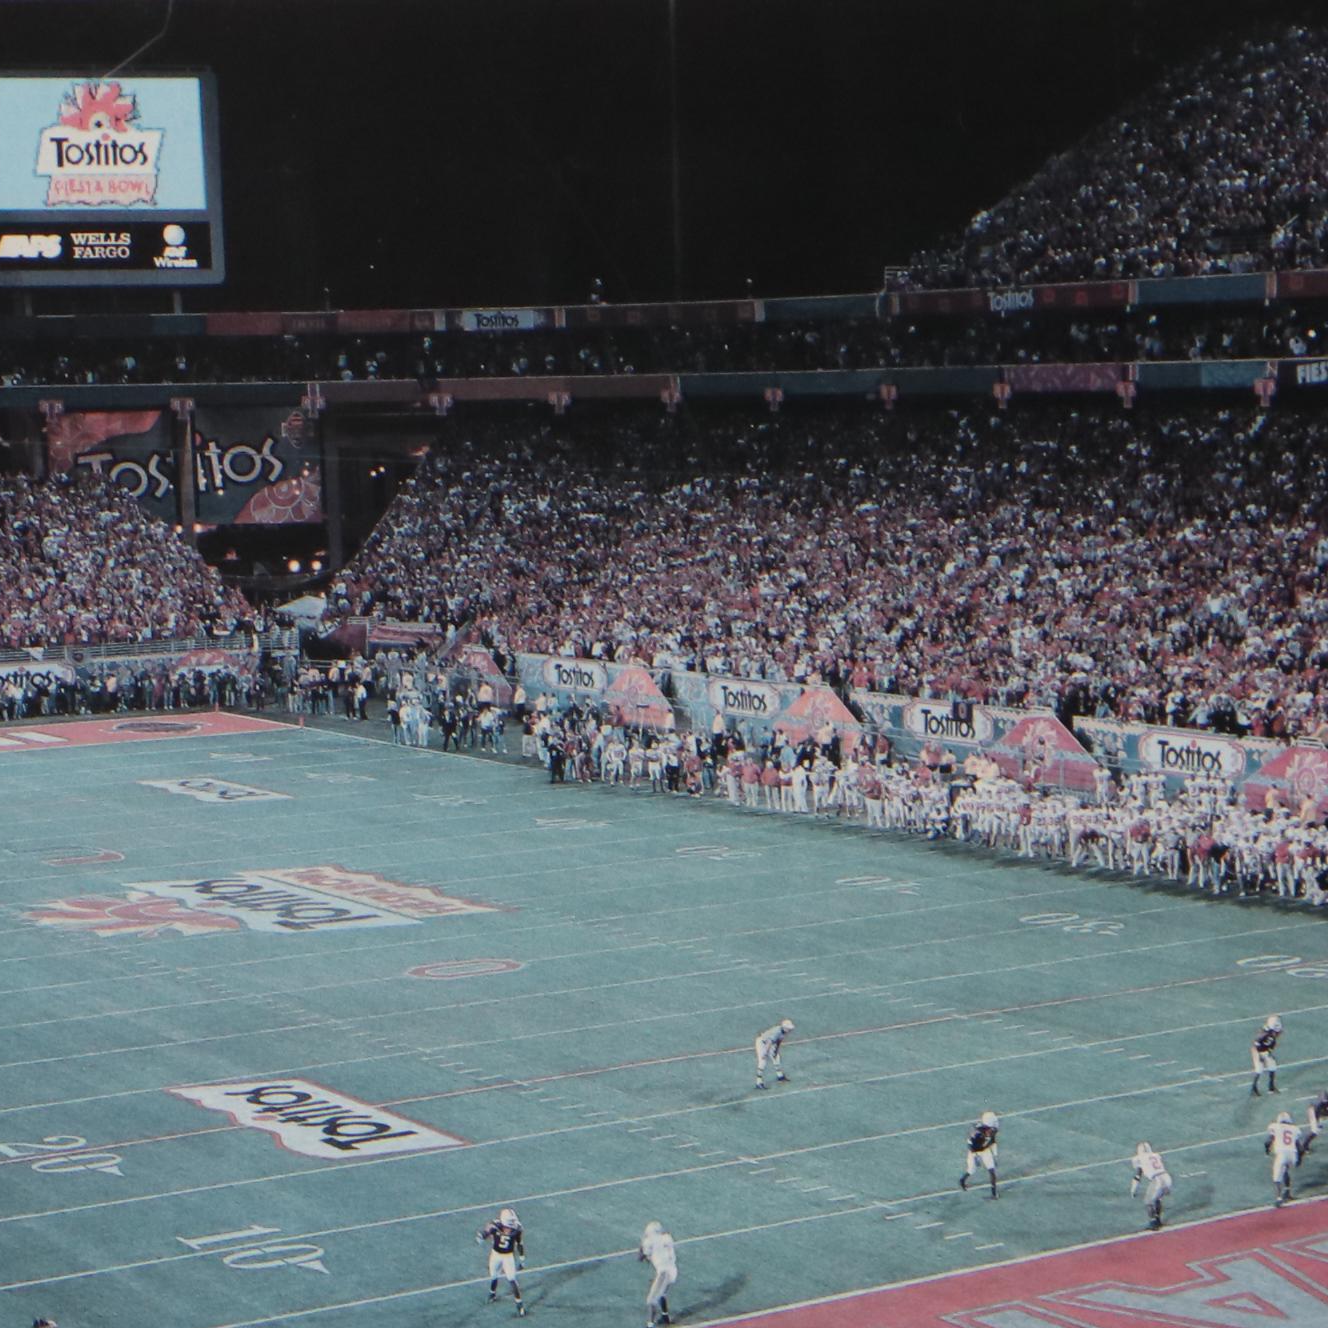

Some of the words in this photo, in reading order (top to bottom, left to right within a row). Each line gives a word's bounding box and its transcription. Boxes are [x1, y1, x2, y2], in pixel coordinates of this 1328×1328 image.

[50, 133, 148, 168] Tostitos
[54, 180, 104, 194] FIESTA
[108, 180, 151, 195] BOWL
[70, 233, 131, 245] WELLS
[72, 247, 131, 259] FARGO
[475, 313, 519, 328] Tostitos
[553, 661, 595, 689] Tostitos
[721, 684, 768, 712] Tostitos
[1157, 738, 1223, 773] Tostitos
[224, 1079, 418, 1152] Tostitos
[1282, 1130, 1293, 1146] 6
[175, 1223, 322, 1274] 10
